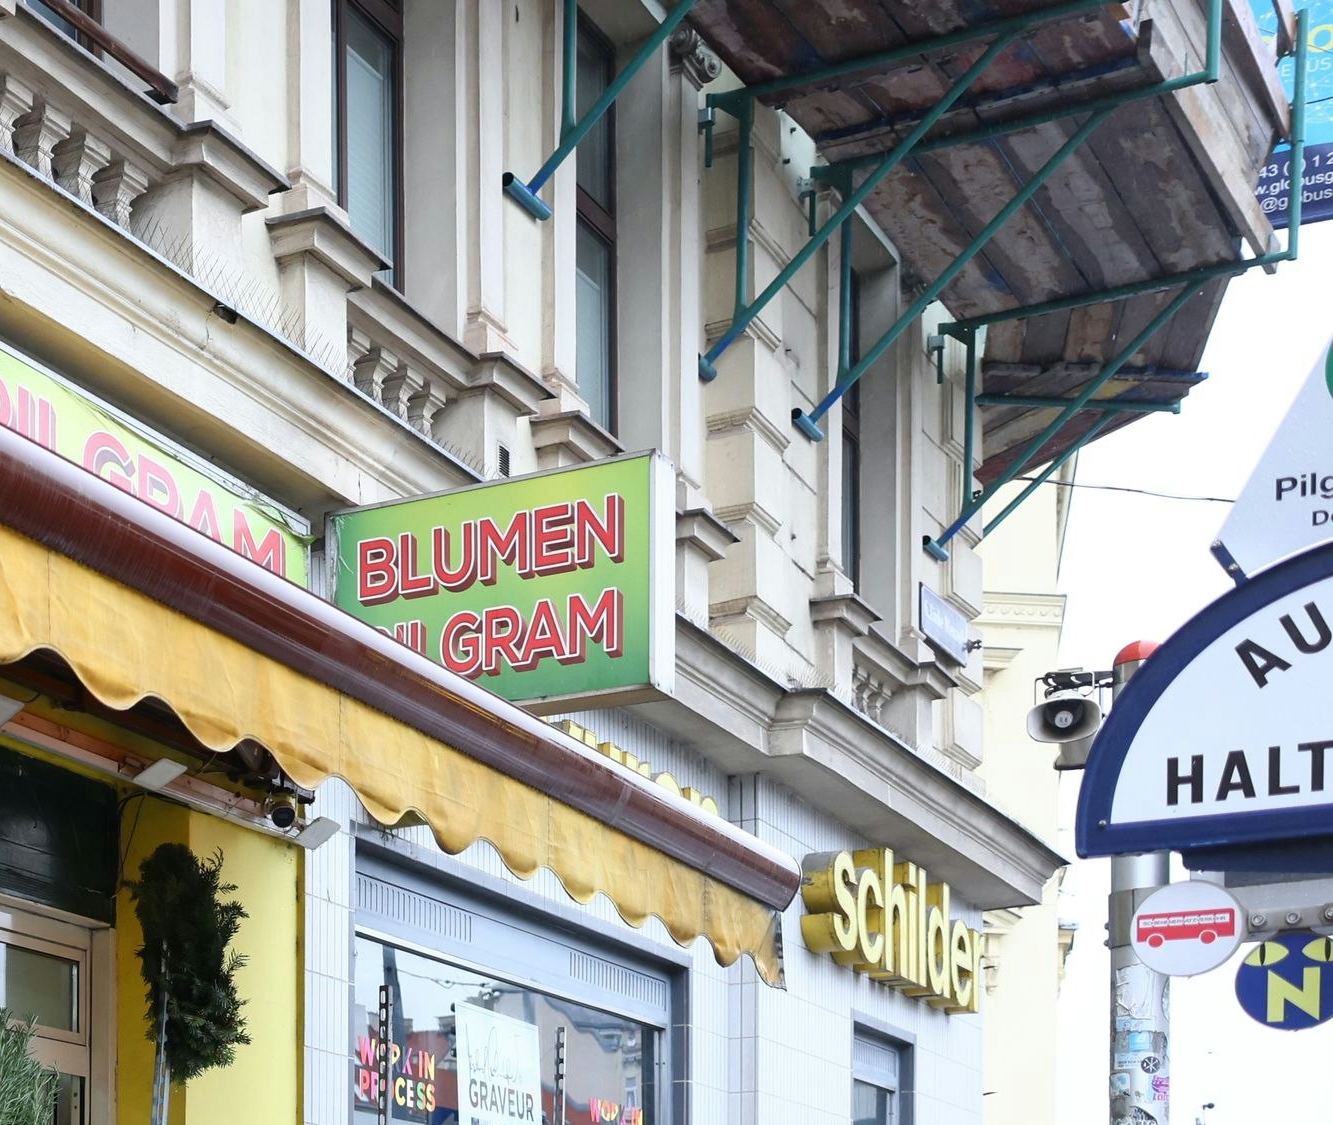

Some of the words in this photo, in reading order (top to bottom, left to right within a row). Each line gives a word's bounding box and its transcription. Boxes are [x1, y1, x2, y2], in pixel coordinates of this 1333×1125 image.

[357, 492, 625, 607] BLUMEN
[374, 587, 624, 681] GRAM
[1166, 739, 1333, 807] HALT
[1266, 966, 1321, 1022] N
[469, 1079, 534, 1123] GRAVEUR
